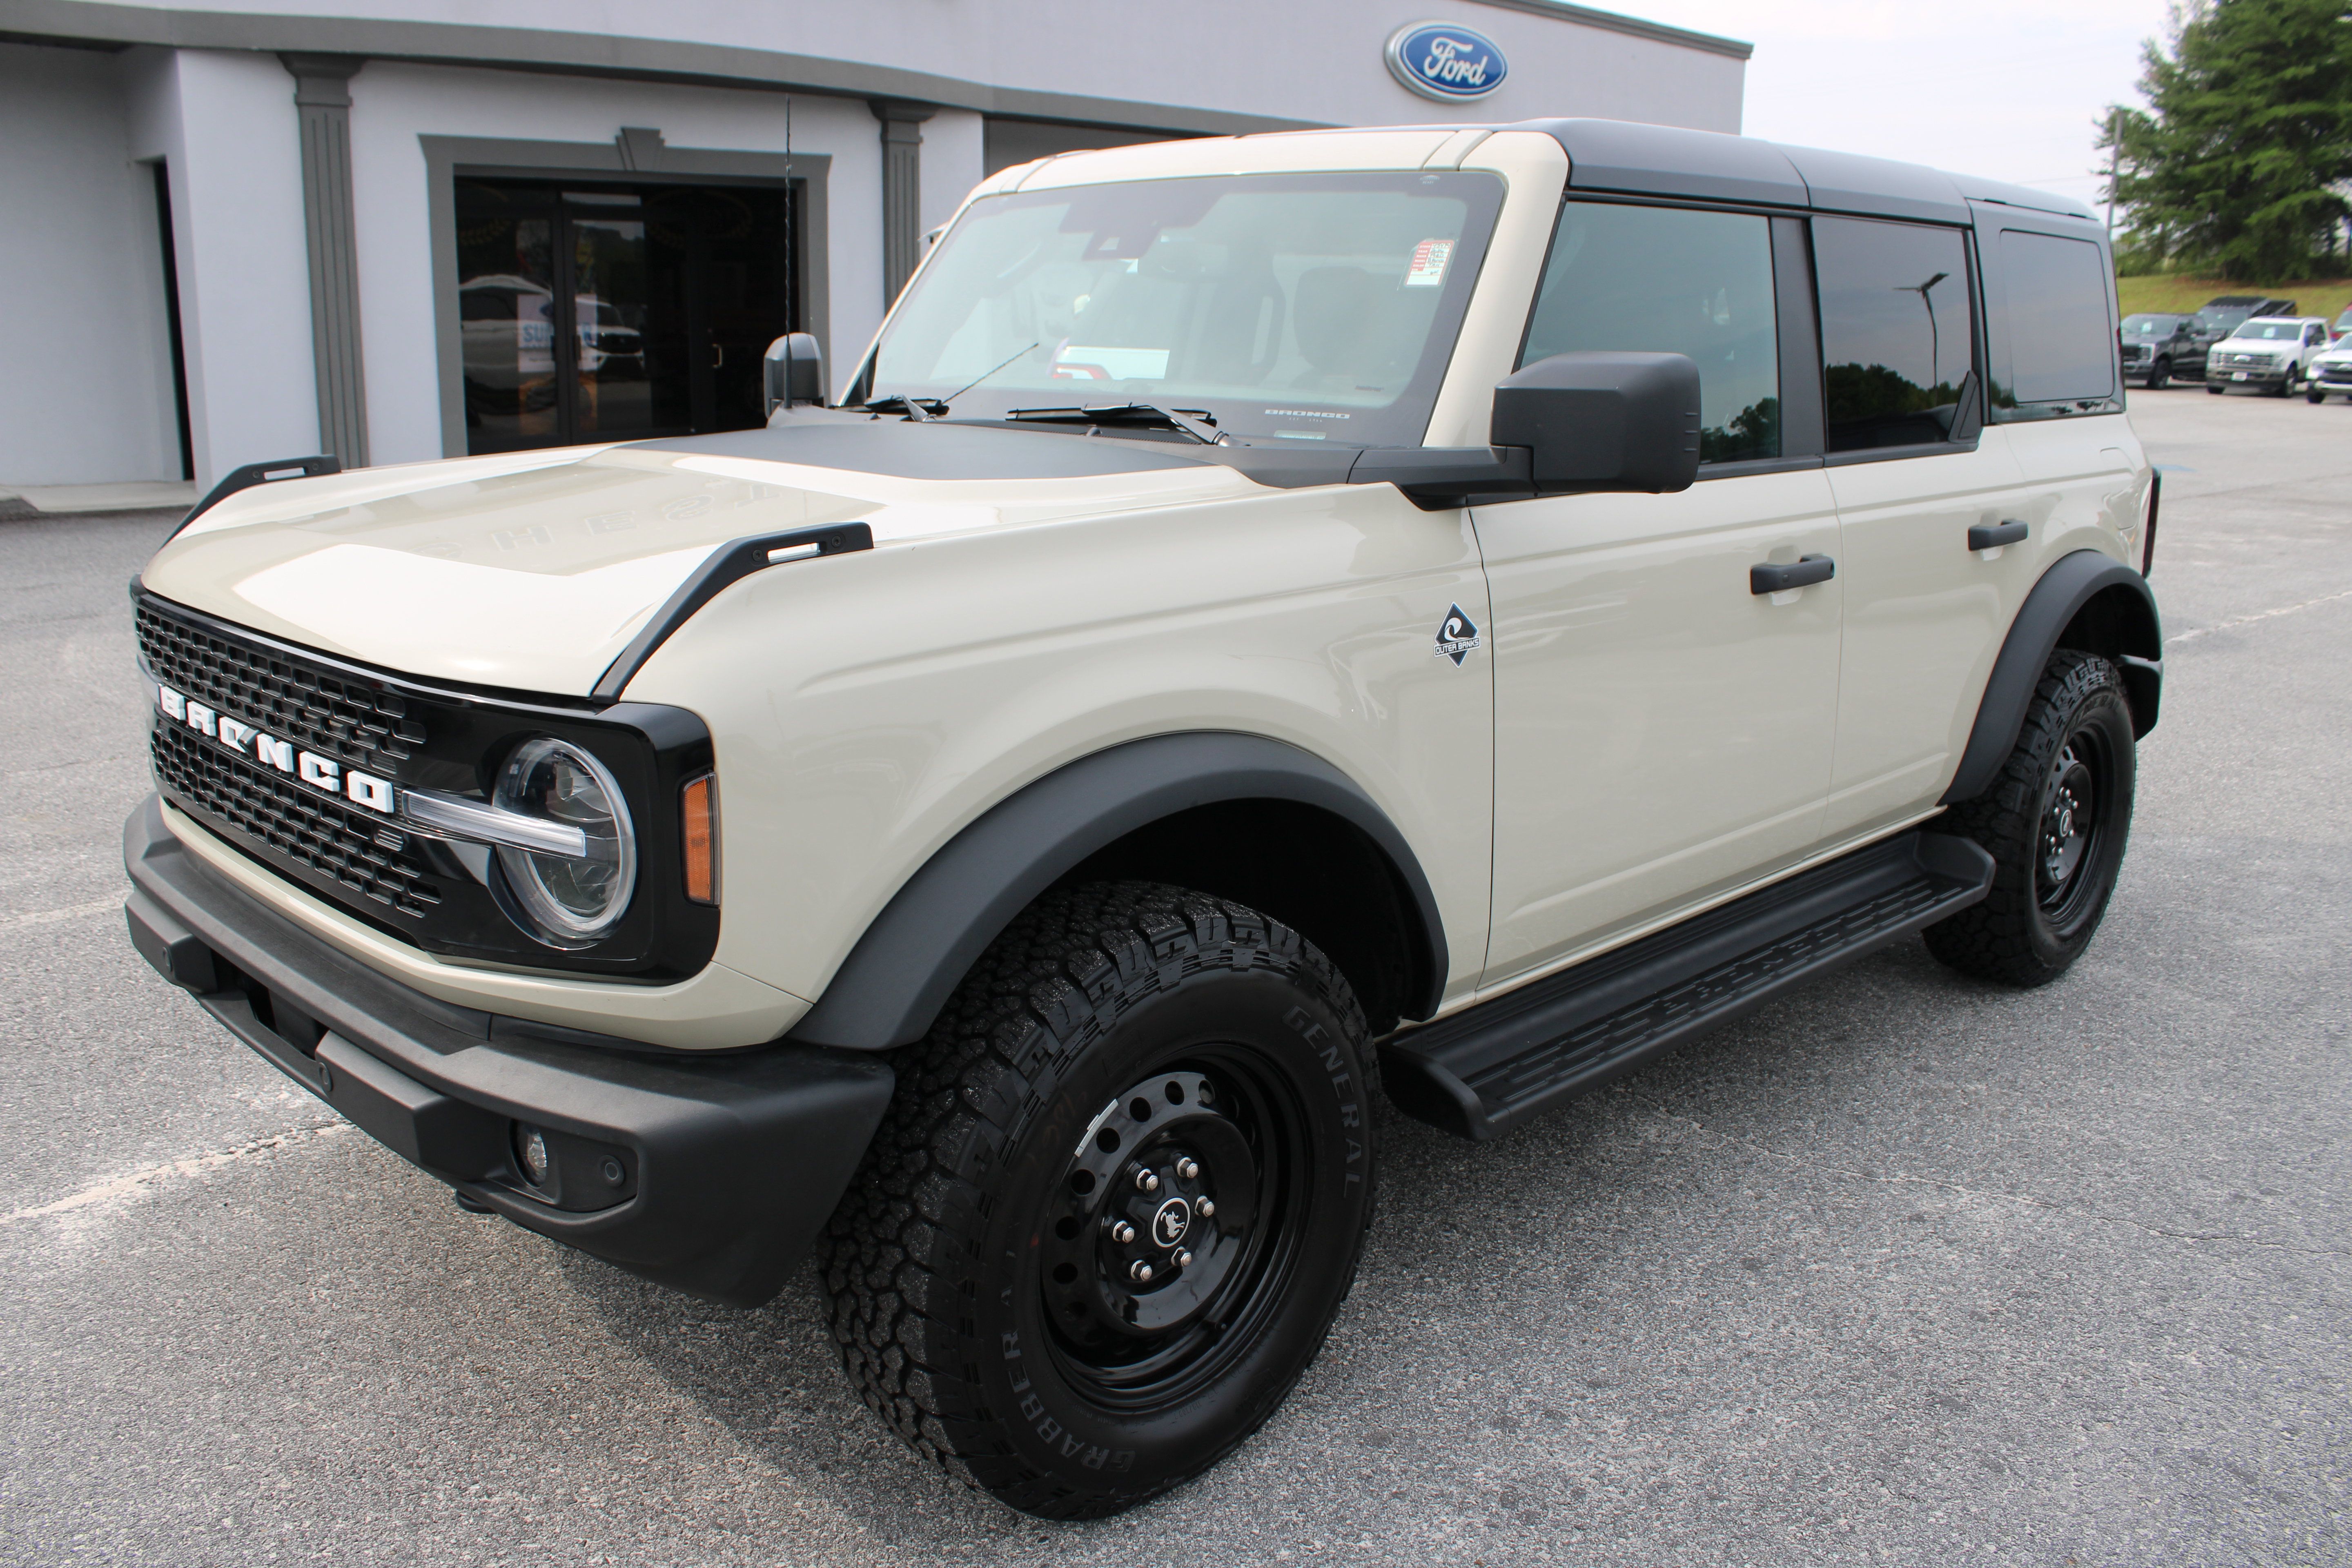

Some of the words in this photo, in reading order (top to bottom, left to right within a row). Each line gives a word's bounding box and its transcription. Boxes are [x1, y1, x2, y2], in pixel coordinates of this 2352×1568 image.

[1423, 37, 1488, 86] Ford
[1265, 409, 1350, 419] BRONCO
[1436, 643, 1457, 655] OUTER
[1458, 639, 1479, 650] BANKS
[160, 685, 394, 813] BRONCO
[1282, 1004, 1362, 1199] GENERAL
[1000, 1328, 1136, 1472] GRABBER
